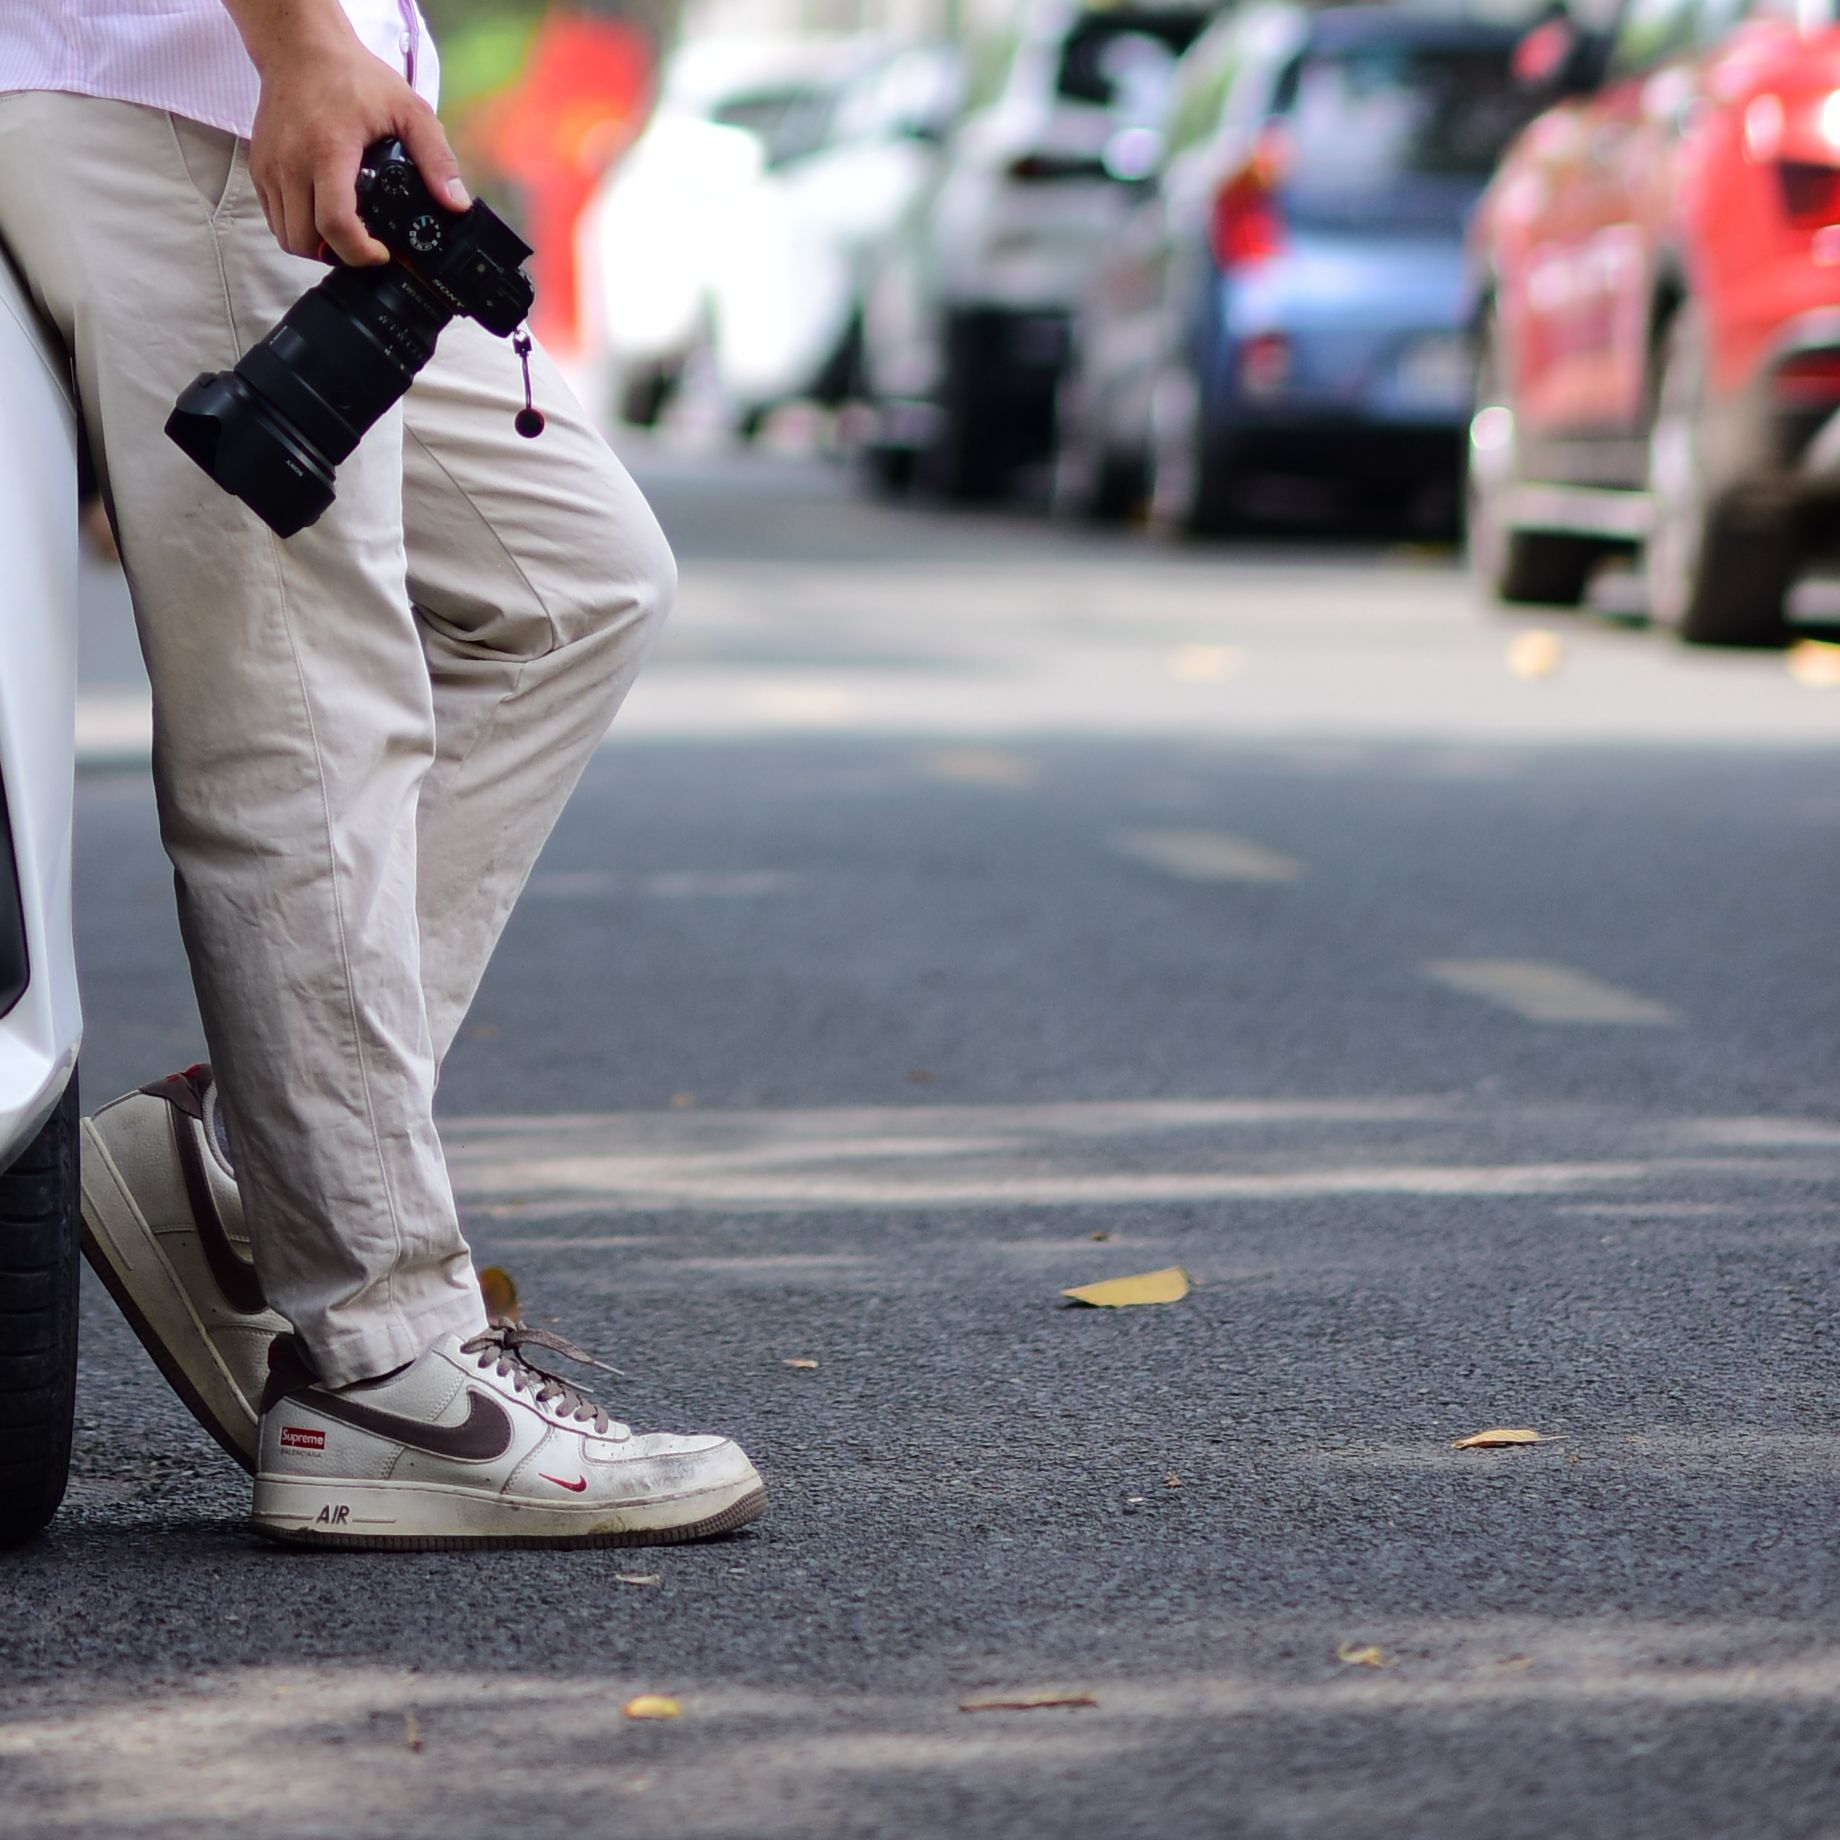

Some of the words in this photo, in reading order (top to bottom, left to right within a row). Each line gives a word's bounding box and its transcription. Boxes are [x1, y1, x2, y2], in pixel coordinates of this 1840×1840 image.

[432, 278, 465, 308] SONY
[282, 1428, 324, 1446] Supreme
[316, 1504, 350, 1525] AIR
